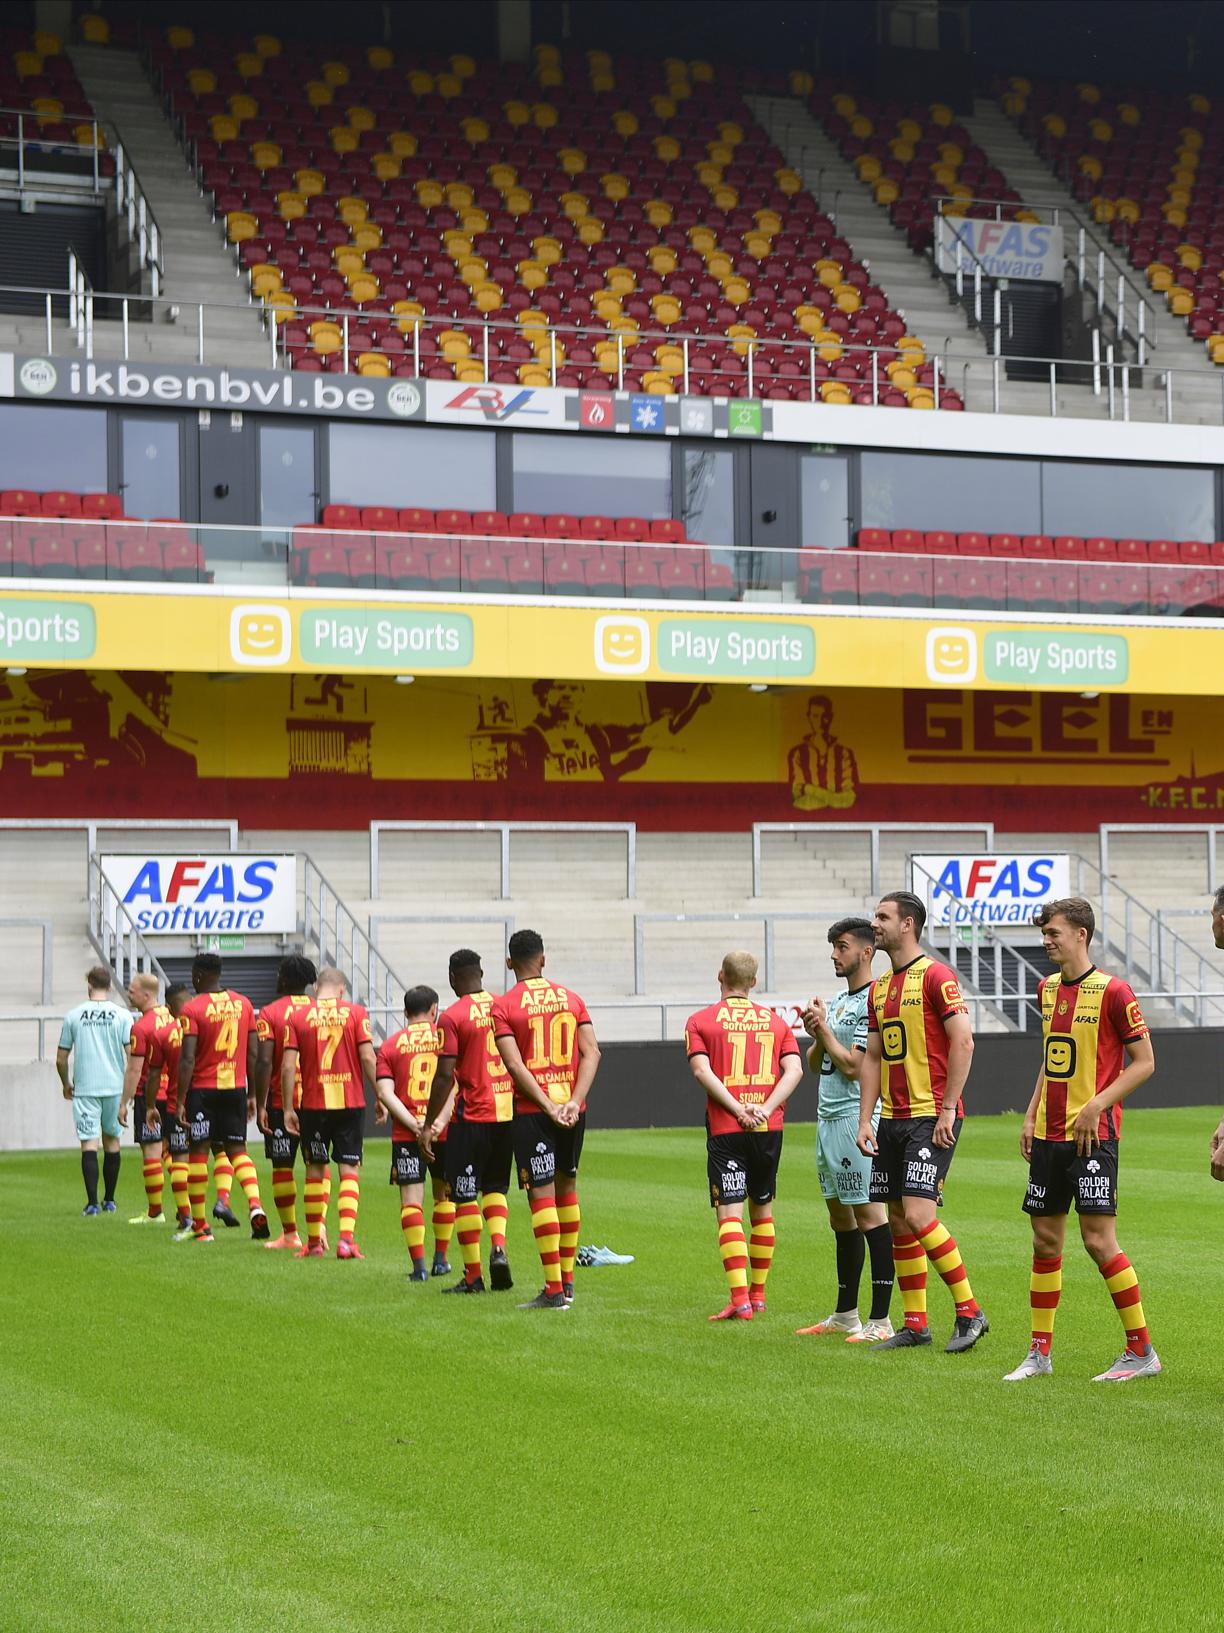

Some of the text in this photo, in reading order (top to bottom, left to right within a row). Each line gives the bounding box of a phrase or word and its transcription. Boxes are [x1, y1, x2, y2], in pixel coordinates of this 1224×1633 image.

[947, 221, 1053, 259] AFAS
[69, 363, 375, 412] ikbenbvl.be
[314, 618, 460, 656] Play Sports
[670, 630, 803, 664] Play Sports
[995, 641, 1117, 673] Play Sports
[903, 688, 1156, 753] GEEL
[122, 860, 278, 904] AFAS
[933, 859, 1054, 898] AFAS
[136, 904, 265, 930] software
[205, 1000, 242, 1017] AFAS
[520, 988, 568, 1008] AFAS
[902, 998, 921, 1006] AFAS
[80, 1010, 116, 1020] AFAS
[306, 1007, 350, 1021] AFAS
[716, 1008, 772, 1023] AFAS
[1074, 1016, 1098, 1024] AFAS
[722, 1021, 770, 1031] software
[215, 1020, 238, 1059] 4
[318, 1026, 344, 1070] 7
[527, 1012, 577, 1069] 10
[723, 1032, 776, 1087] 11
[408, 1052, 438, 1100] 8
[739, 1092, 765, 1104] STORM
[907, 1171, 936, 1185] PALACE
[908, 1161, 937, 1174] GOLDEN
[870, 1185, 889, 1193] airco
[1079, 1177, 1109, 1187] GOLDEN
[1080, 1187, 1109, 1198] PALACE
